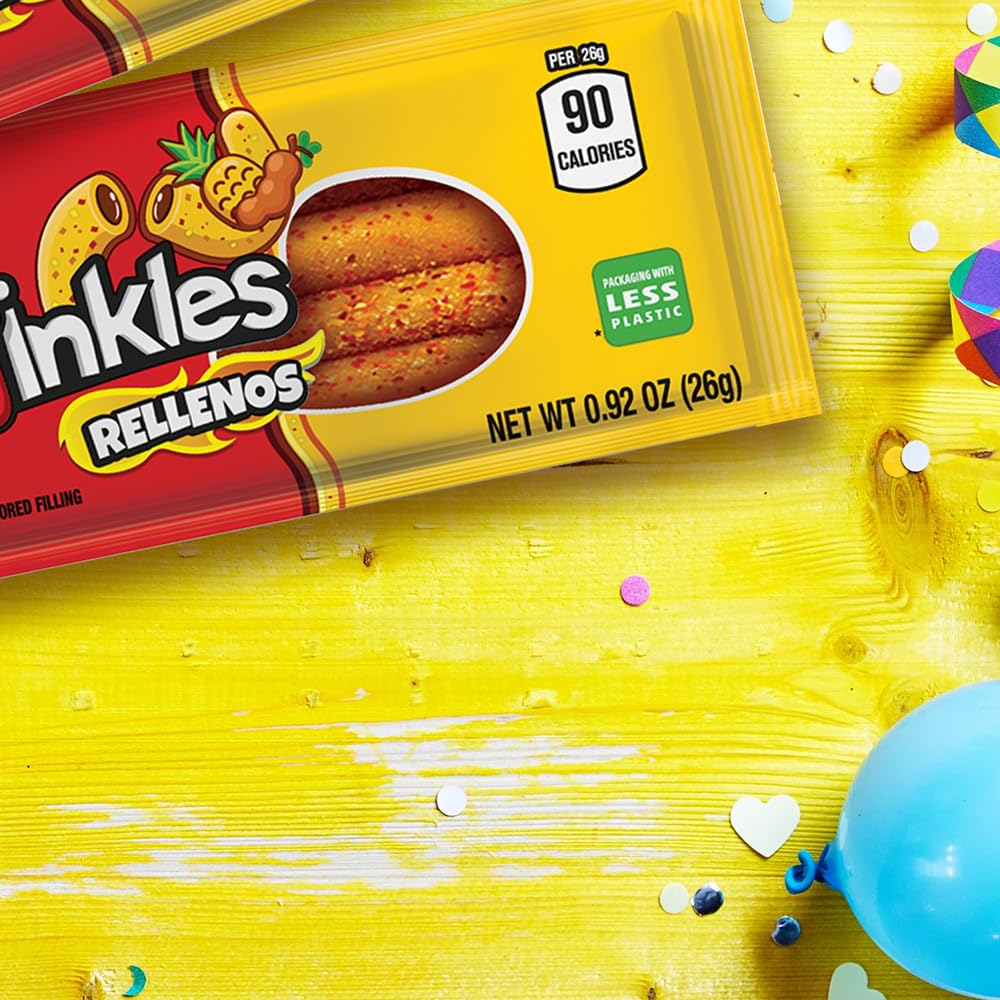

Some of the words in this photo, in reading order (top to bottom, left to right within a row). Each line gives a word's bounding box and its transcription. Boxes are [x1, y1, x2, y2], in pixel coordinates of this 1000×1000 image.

[548, 50, 576, 69] PER
[580, 45, 606, 65] 26g
[561, 84, 614, 134] 90
[558, 138, 637, 171] CALORIES
[602, 269, 652, 288] PACKAGING
[652, 265, 675, 281] WITH
[606, 281, 680, 312] LESS
[611, 305, 682, 330] PLASTIC
[89, 363, 304, 460] RELLENOS
[486, 406, 532, 443] NET
[538, 396, 577, 432] WT
[585, 387, 634, 424] 0.92
[642, 378, 676, 412] OZ
[680, 364, 742, 411] (26g)
[34, 489, 83, 512] FILLING
